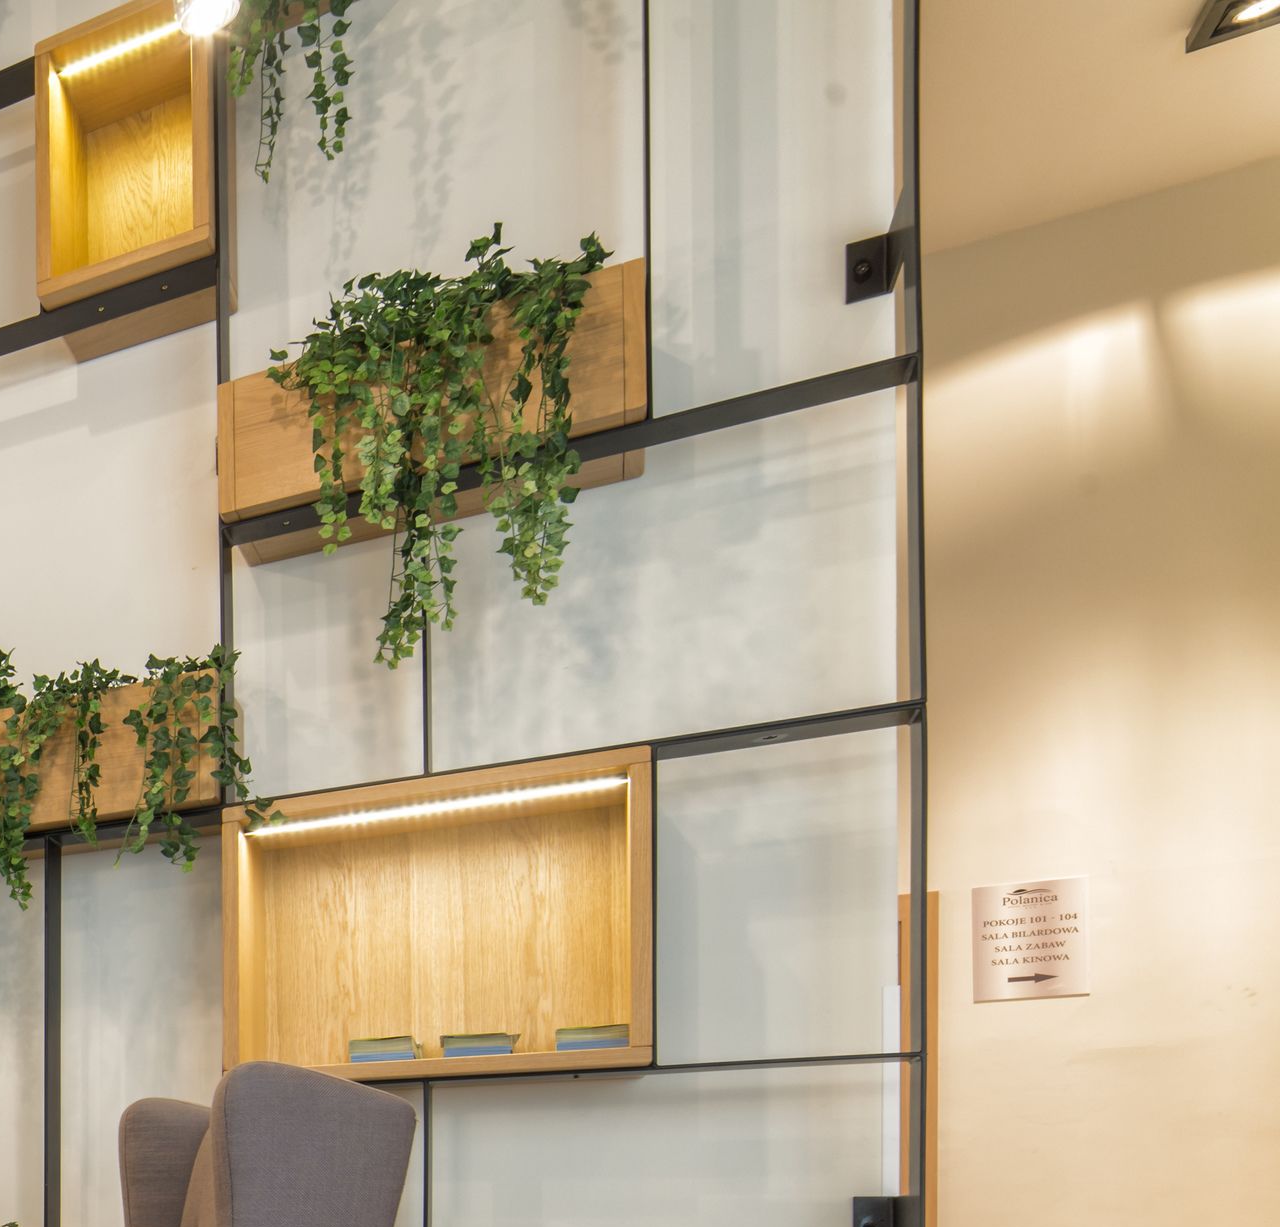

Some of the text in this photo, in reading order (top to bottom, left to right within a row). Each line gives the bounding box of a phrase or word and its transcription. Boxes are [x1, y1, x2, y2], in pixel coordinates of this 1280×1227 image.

[1002, 894, 1058, 906] Polanica
[983, 917, 1027, 928] POKOJE
[1030, 915, 1047, 924] 101
[1059, 913, 1078, 921] 104
[981, 926, 1079, 941] SALA BILARDOWA
[994, 940, 1066, 953] SALA ZABAW
[991, 953, 1070, 966] SALA KINOWA
